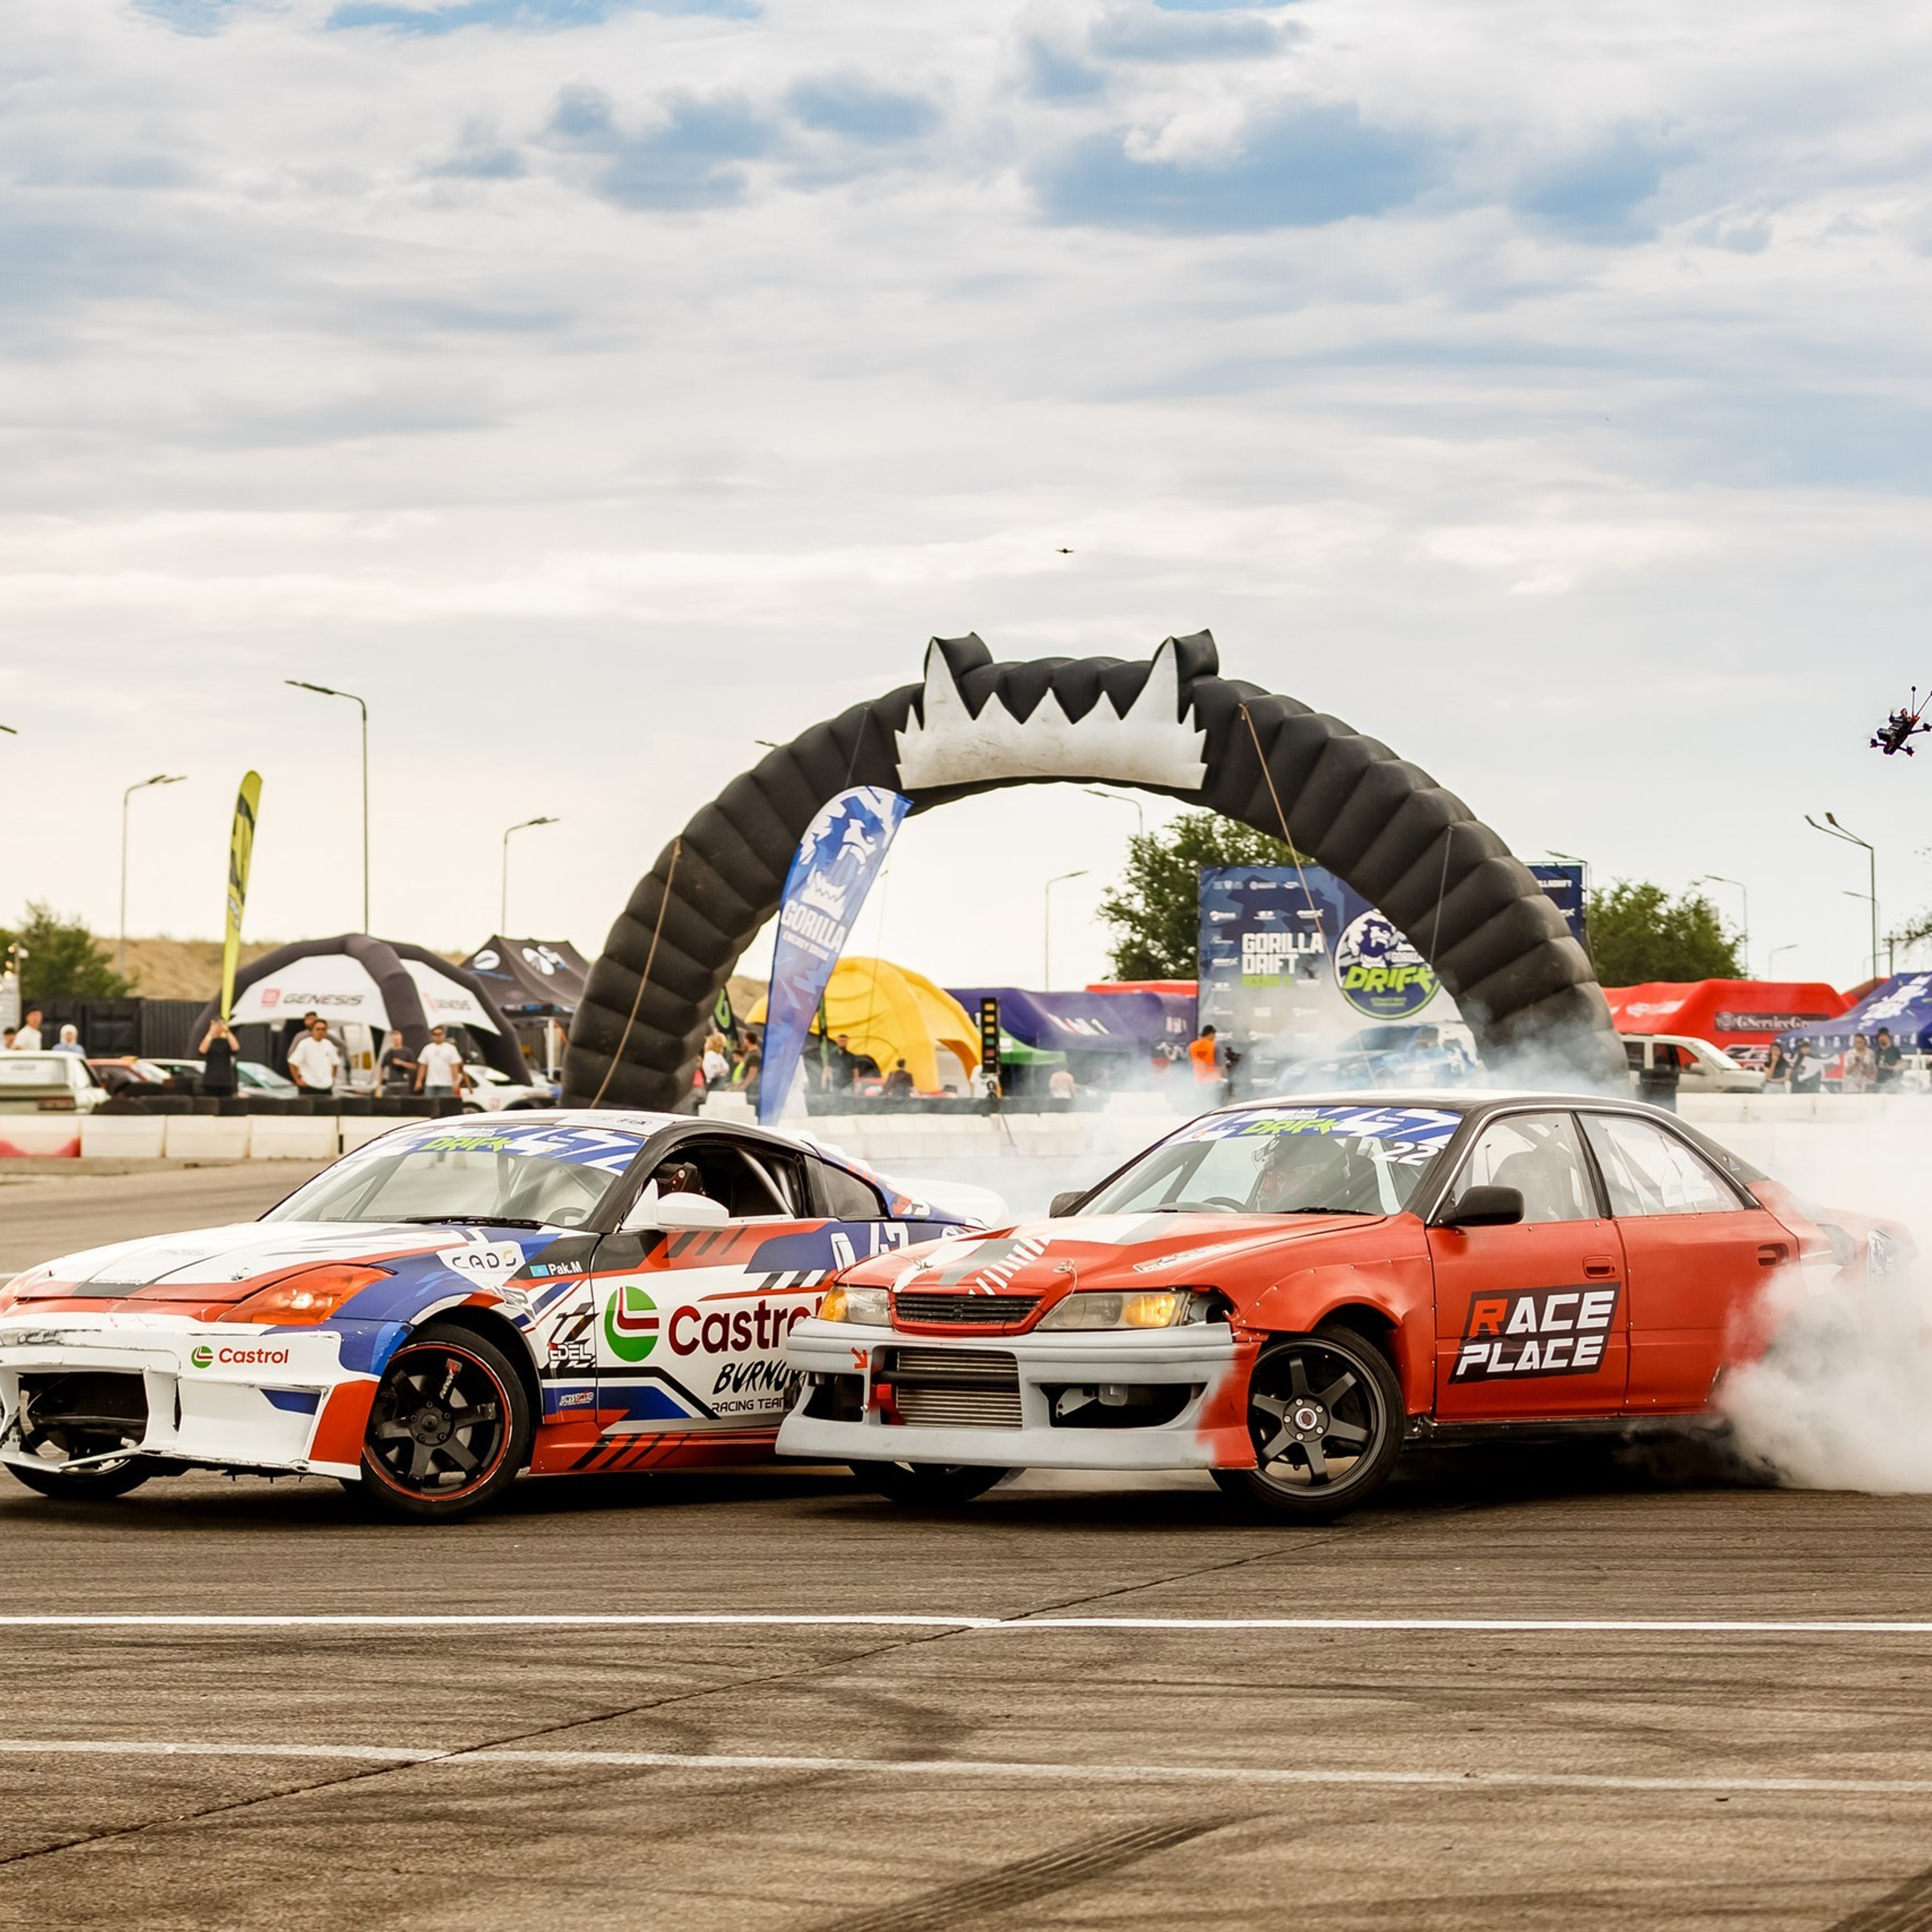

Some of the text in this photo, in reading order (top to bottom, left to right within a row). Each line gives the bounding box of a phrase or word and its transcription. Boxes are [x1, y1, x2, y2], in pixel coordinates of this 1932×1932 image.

[780, 899, 846, 953] GORILLA
[1241, 932, 1324, 953] GORILLA
[1241, 953, 1300, 974] DRIFT
[1343, 965, 1435, 994] DRIFT
[283, 993, 364, 1006] GENESIS
[1238, 1118, 1342, 1135] DRIFT
[417, 1136, 512, 1152] DRIFT
[1371, 1141, 1439, 1167] 22
[452, 1249, 516, 1269] CADS
[548, 1261, 583, 1275] Pak.M
[1468, 1290, 1615, 1337] RACE
[219, 1348, 289, 1364] Castrol
[1456, 1335, 1604, 1376] PLACE
[711, 1400, 754, 1414] RACING
